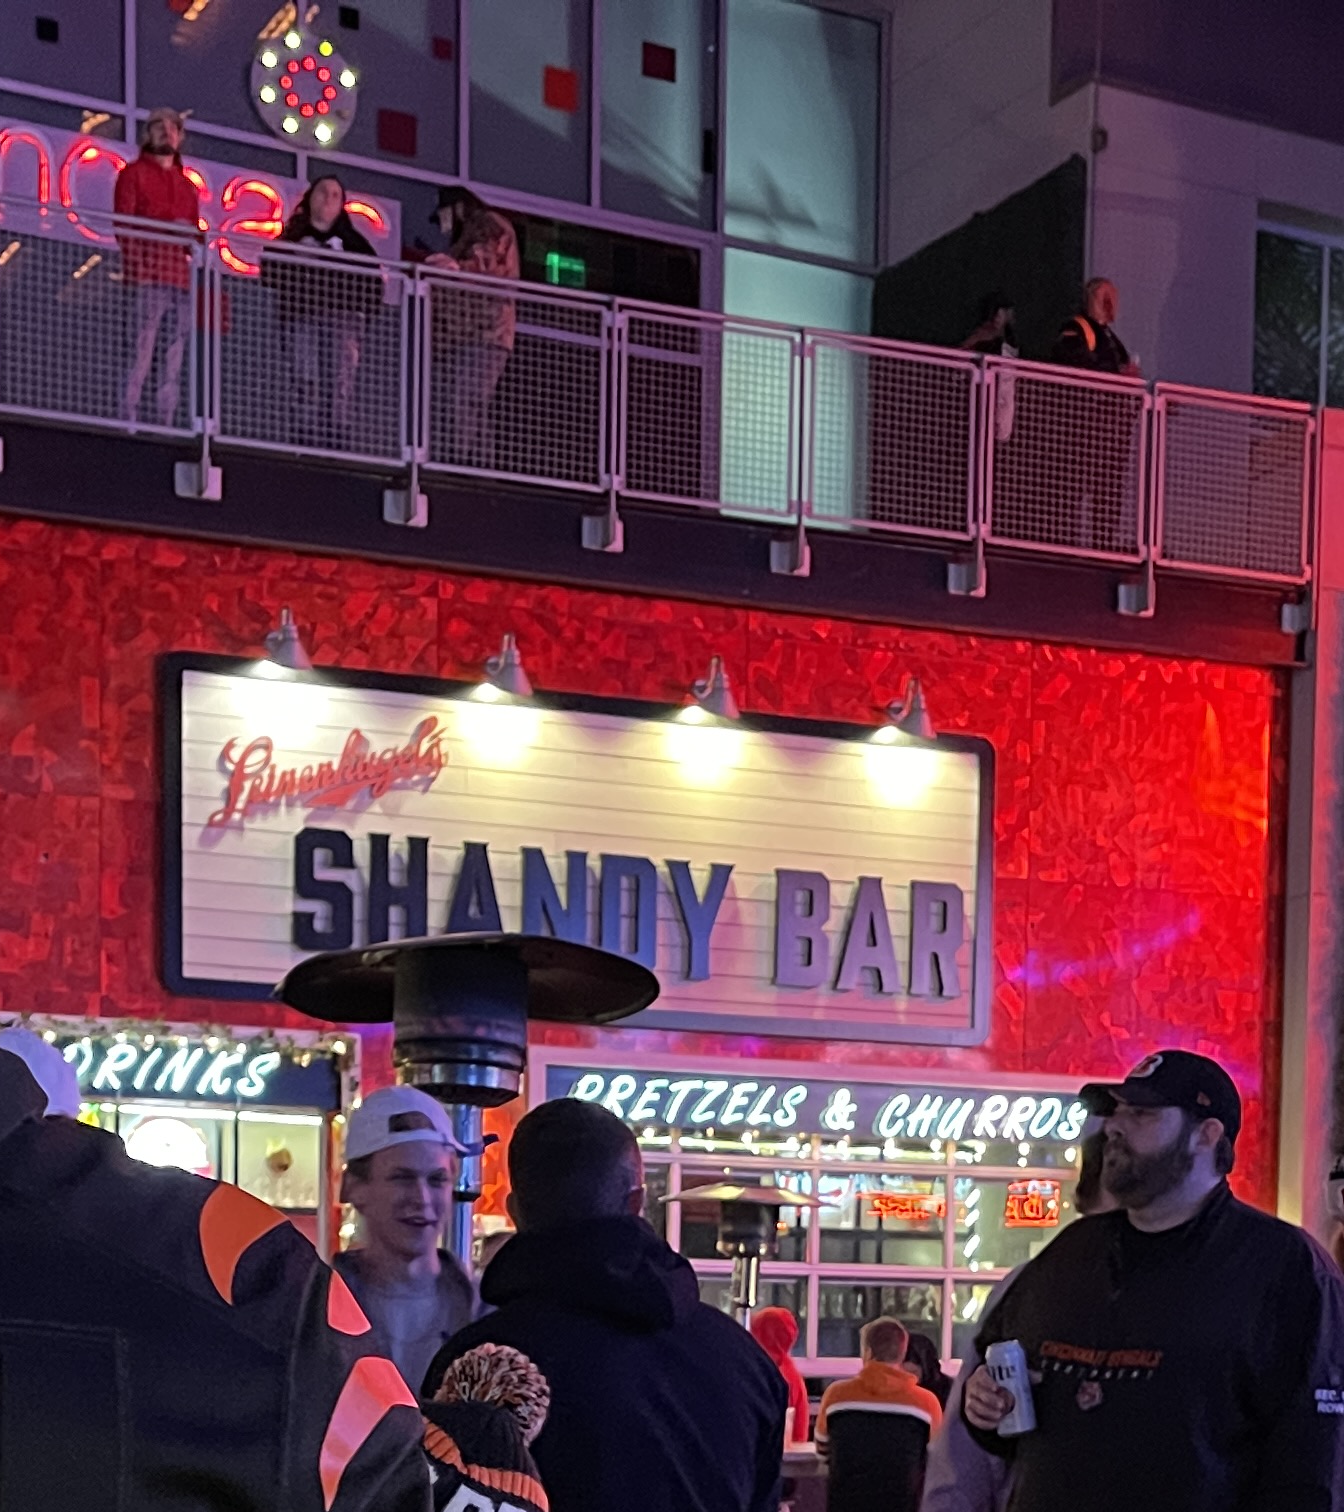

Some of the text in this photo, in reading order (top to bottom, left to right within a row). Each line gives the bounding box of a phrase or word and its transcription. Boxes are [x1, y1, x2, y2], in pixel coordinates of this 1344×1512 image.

[208, 715, 448, 828] Leinenkugel's
[292, 826, 964, 999] SHANDY BAR
[573, 1073, 1088, 1141] PRETZELS & CHURROS
